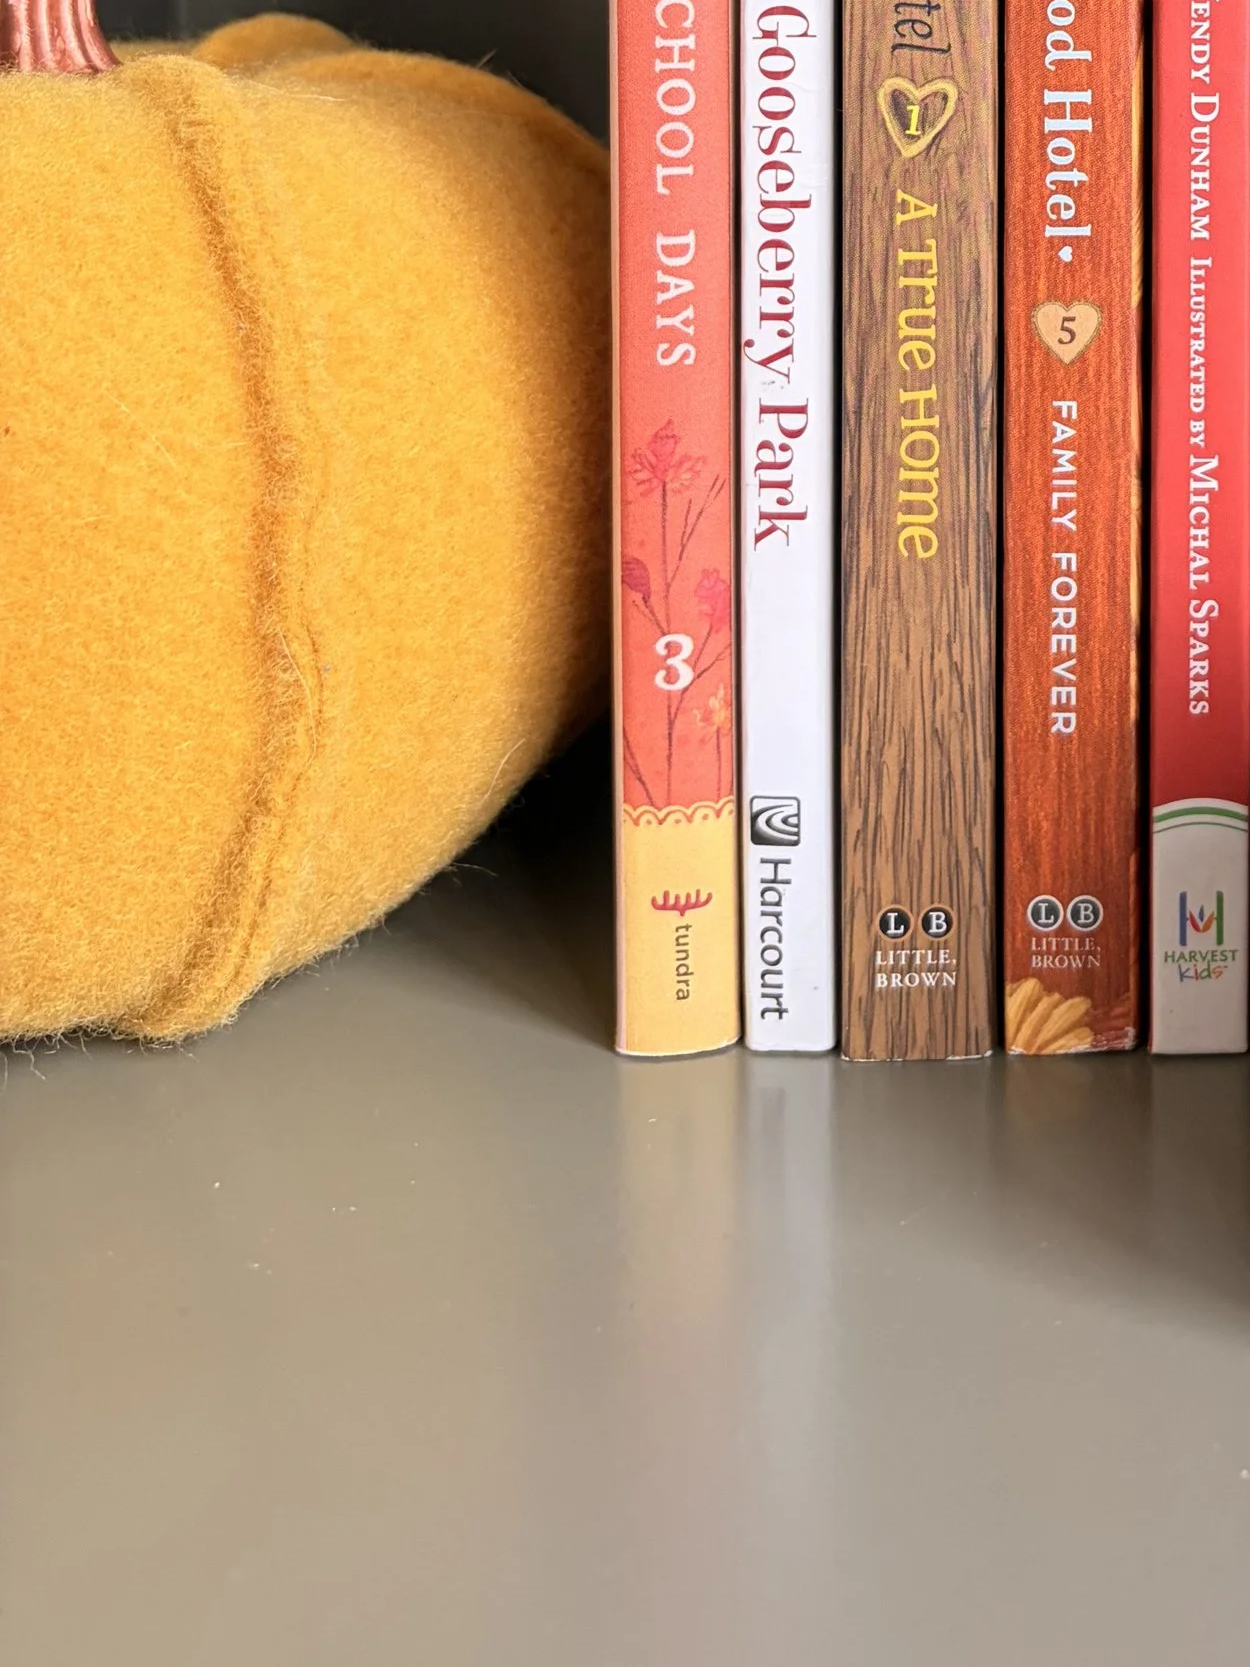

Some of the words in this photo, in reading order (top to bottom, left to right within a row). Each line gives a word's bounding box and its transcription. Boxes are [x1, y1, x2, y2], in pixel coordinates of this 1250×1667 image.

[905, 104, 922, 136] 1
[743, 5, 817, 382] Gooseberry
[1043, 89, 1094, 238] Hotel
[1189, 92, 1220, 240] DUNHAM
[896, 188, 938, 226] A
[656, 230, 696, 367] DAYS
[1057, 316, 1077, 344] 5
[752, 397, 809, 551] Park
[1050, 399, 1078, 532] FAMILY
[654, 633, 694, 691] 3
[1050, 553, 1078, 735] FOREVER
[675, 924, 694, 1001] tundra
[760, 858, 791, 1019] Harcourt
[876, 949, 957, 966] LITTLE,
[1030, 937, 1101, 952] LITTLE,
[1031, 954, 1101, 968] BROWN
[1164, 949, 1238, 962] HARVEST
[876, 971, 957, 988] BROWN
